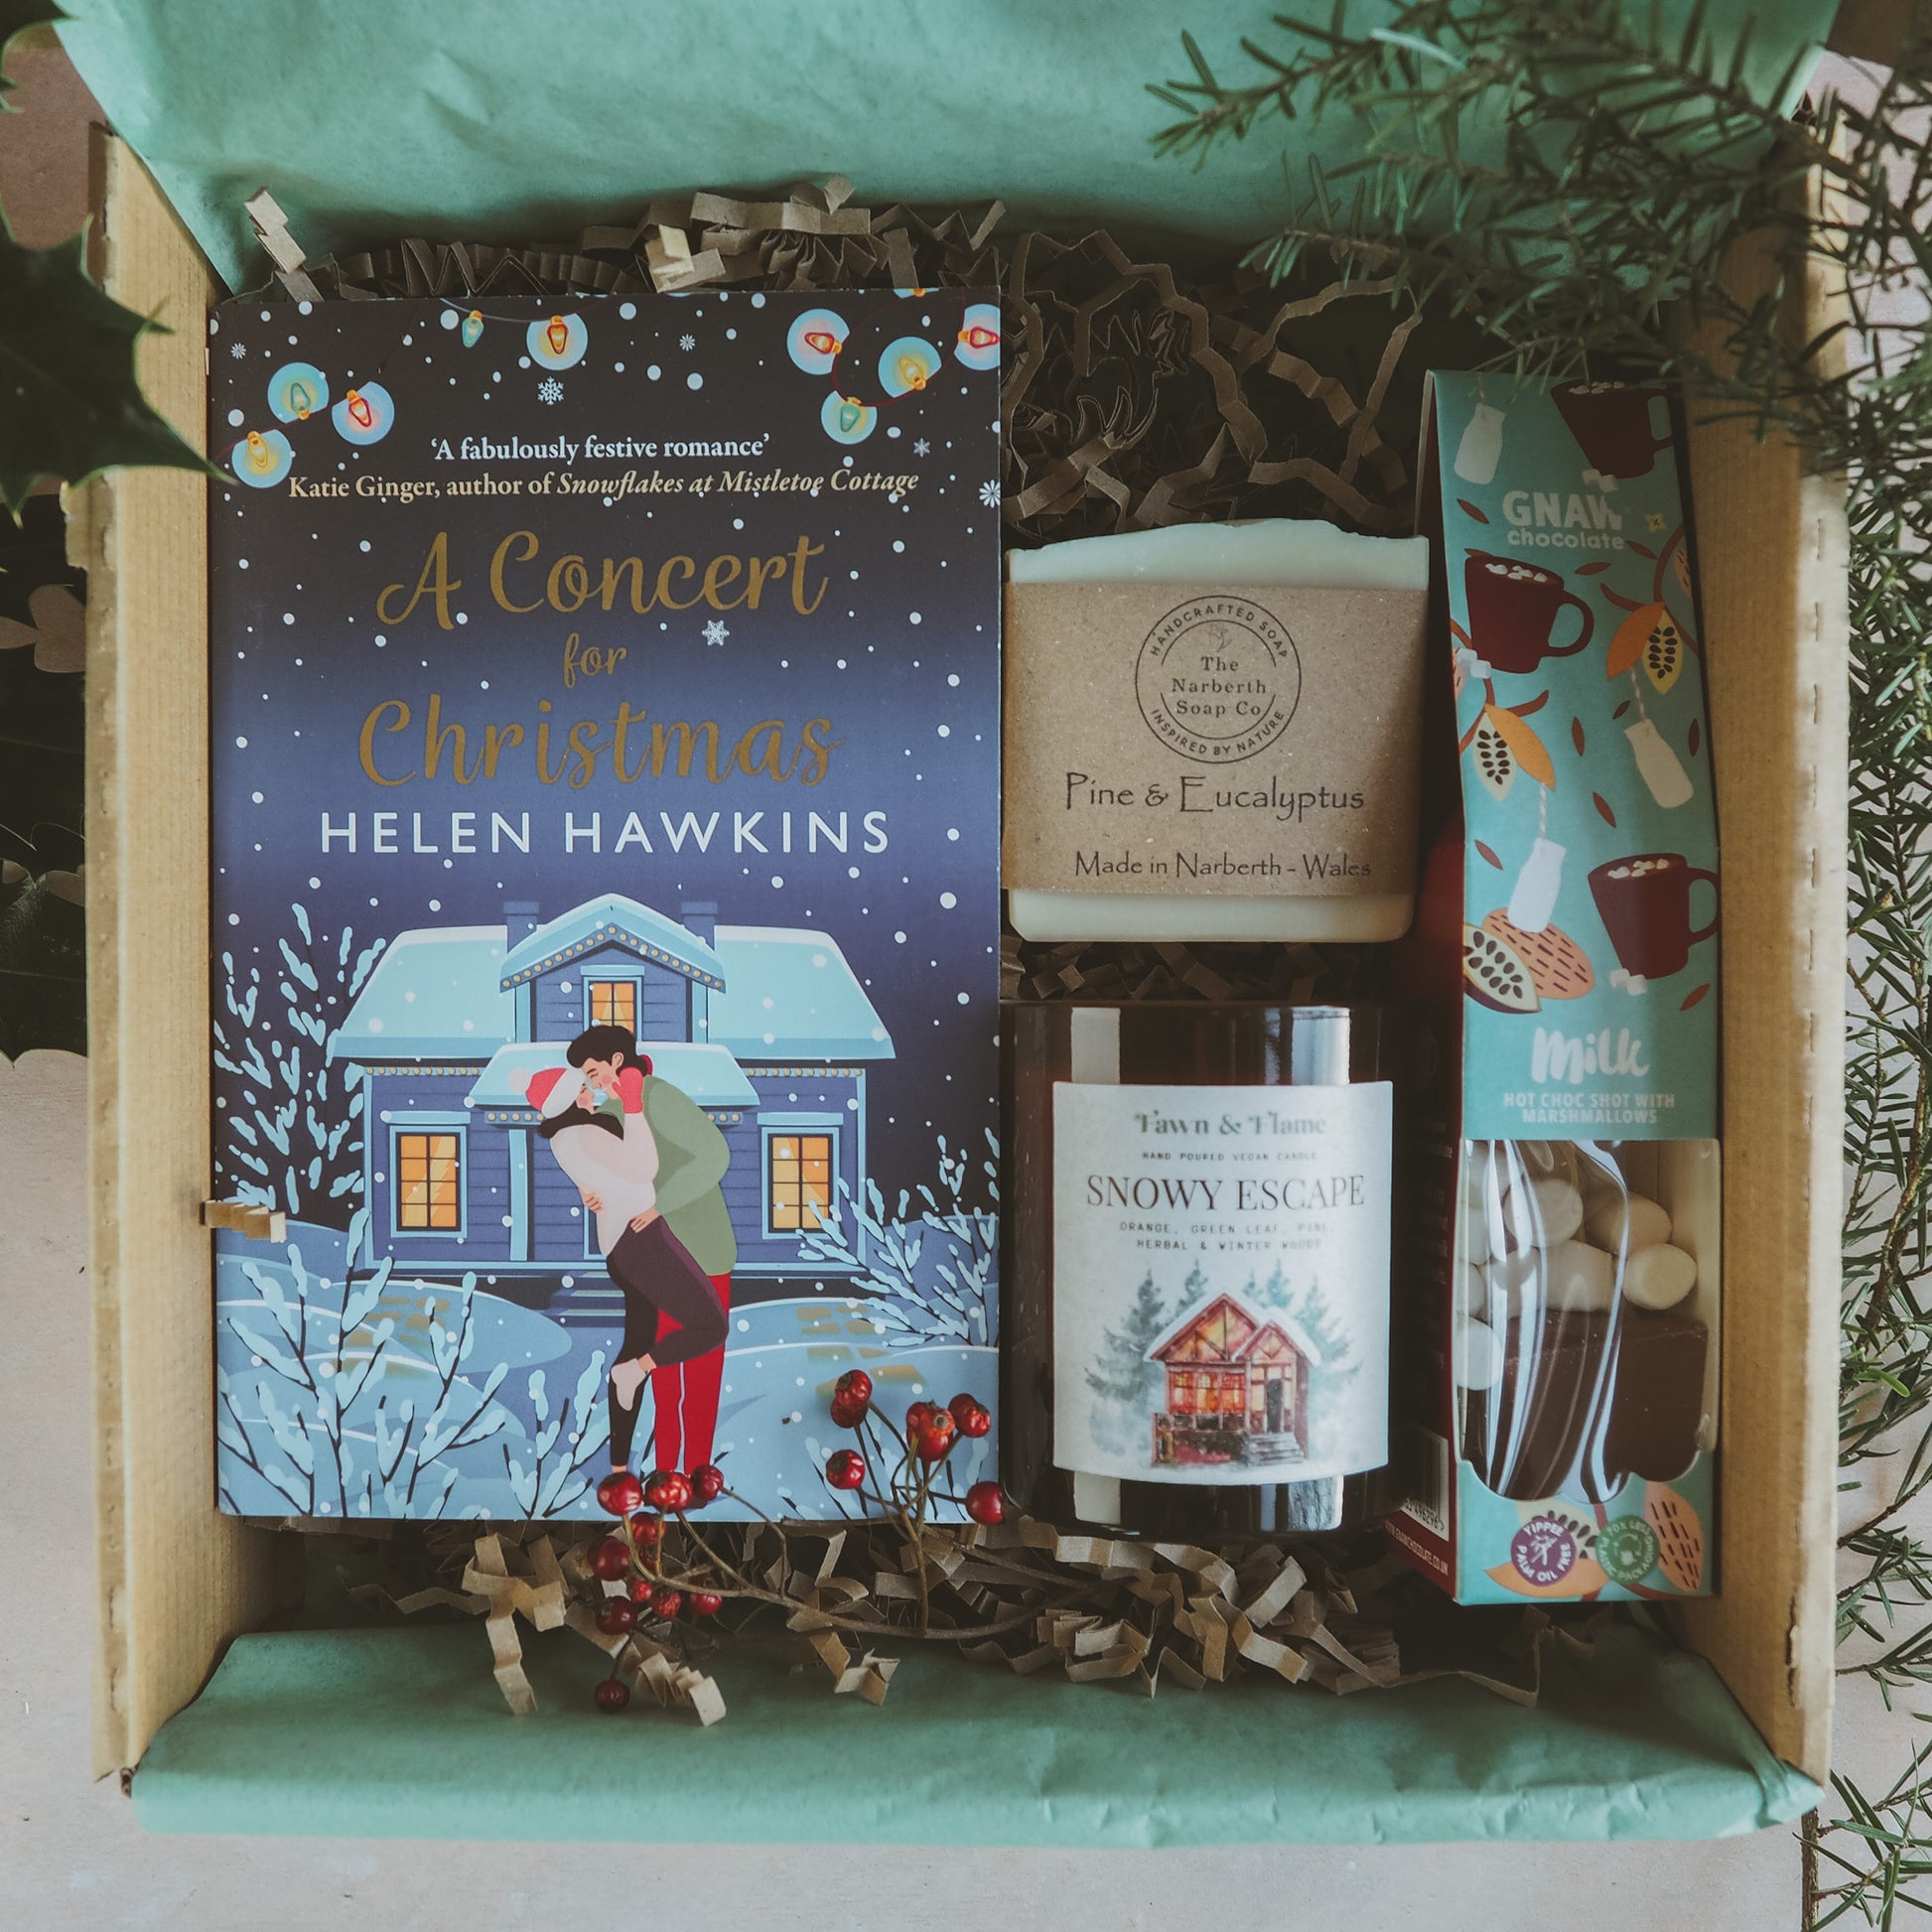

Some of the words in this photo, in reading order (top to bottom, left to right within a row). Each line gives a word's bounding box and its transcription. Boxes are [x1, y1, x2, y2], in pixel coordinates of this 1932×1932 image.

[460, 435, 580, 467] fabulously
[584, 434, 657, 459] festive
[288, 476, 349, 498] Katie
[354, 475, 441, 504] Ginger,
[446, 473, 524, 496] author
[527, 472, 554, 494] of
[556, 470, 684, 500] Snowflakes
[689, 472, 713, 493] at
[717, 469, 824, 492] Mistletoe
[830, 469, 919, 496] Cottage
[1501, 489, 1623, 531] GNAW
[1506, 527, 1625, 551] chocolate
[375, 531, 463, 630] A
[488, 529, 829, 616] Concert
[1151, 603, 1256, 657] HANDCRAFTED
[1258, 620, 1289, 659] SOAP
[562, 632, 627, 689] for
[1200, 655, 1240, 672] The
[1171, 677, 1268, 695] Narberth
[1175, 699, 1227, 718] Soap
[1235, 700, 1262, 717] Co
[358, 693, 846, 790] Christmas
[1150, 708, 1208, 756] INSPIRED
[1212, 744, 1232, 757] BY
[1236, 709, 1286, 754] NATURE
[1064, 771, 1135, 810] Pine
[1145, 782, 1169, 807] &
[1179, 775, 1365, 823] Eucalyptus
[321, 811, 530, 854] HELEN
[564, 810, 890, 854] HAWKINS
[1074, 850, 1143, 877] Made
[1150, 855, 1169, 875] in
[1174, 851, 1282, 878] Narberth
[1302, 852, 1372, 880] Wales
[1503, 1091, 1537, 1108] HOT
[1541, 1092, 1585, 1108] CHOC
[1589, 1092, 1633, 1109] SHOT
[1635, 1093, 1676, 1109] WITH
[1521, 1107, 1658, 1124] MARSHMALLOWS
[1218, 1111, 1242, 1136] &
[1141, 1151, 1173, 1161] HAND
[1179, 1152, 1225, 1162] POURED
[1232, 1152, 1270, 1162] VEGAN
[1086, 1173, 1223, 1211] SNOWY
[1236, 1173, 1366, 1212] ESCAPE
[1190, 1223, 1236, 1235] GREEN
[1136, 1239, 1189, 1251] HERBAL
[1199, 1241, 1208, 1251] &
[1218, 1241, 1272, 1251] WINTER
[1522, 1521, 1566, 1537] YIPPEE
[1516, 1545, 1536, 1579] PALM
[1536, 1570, 1559, 1583] OIL
[1556, 1542, 1572, 1573] FREE
